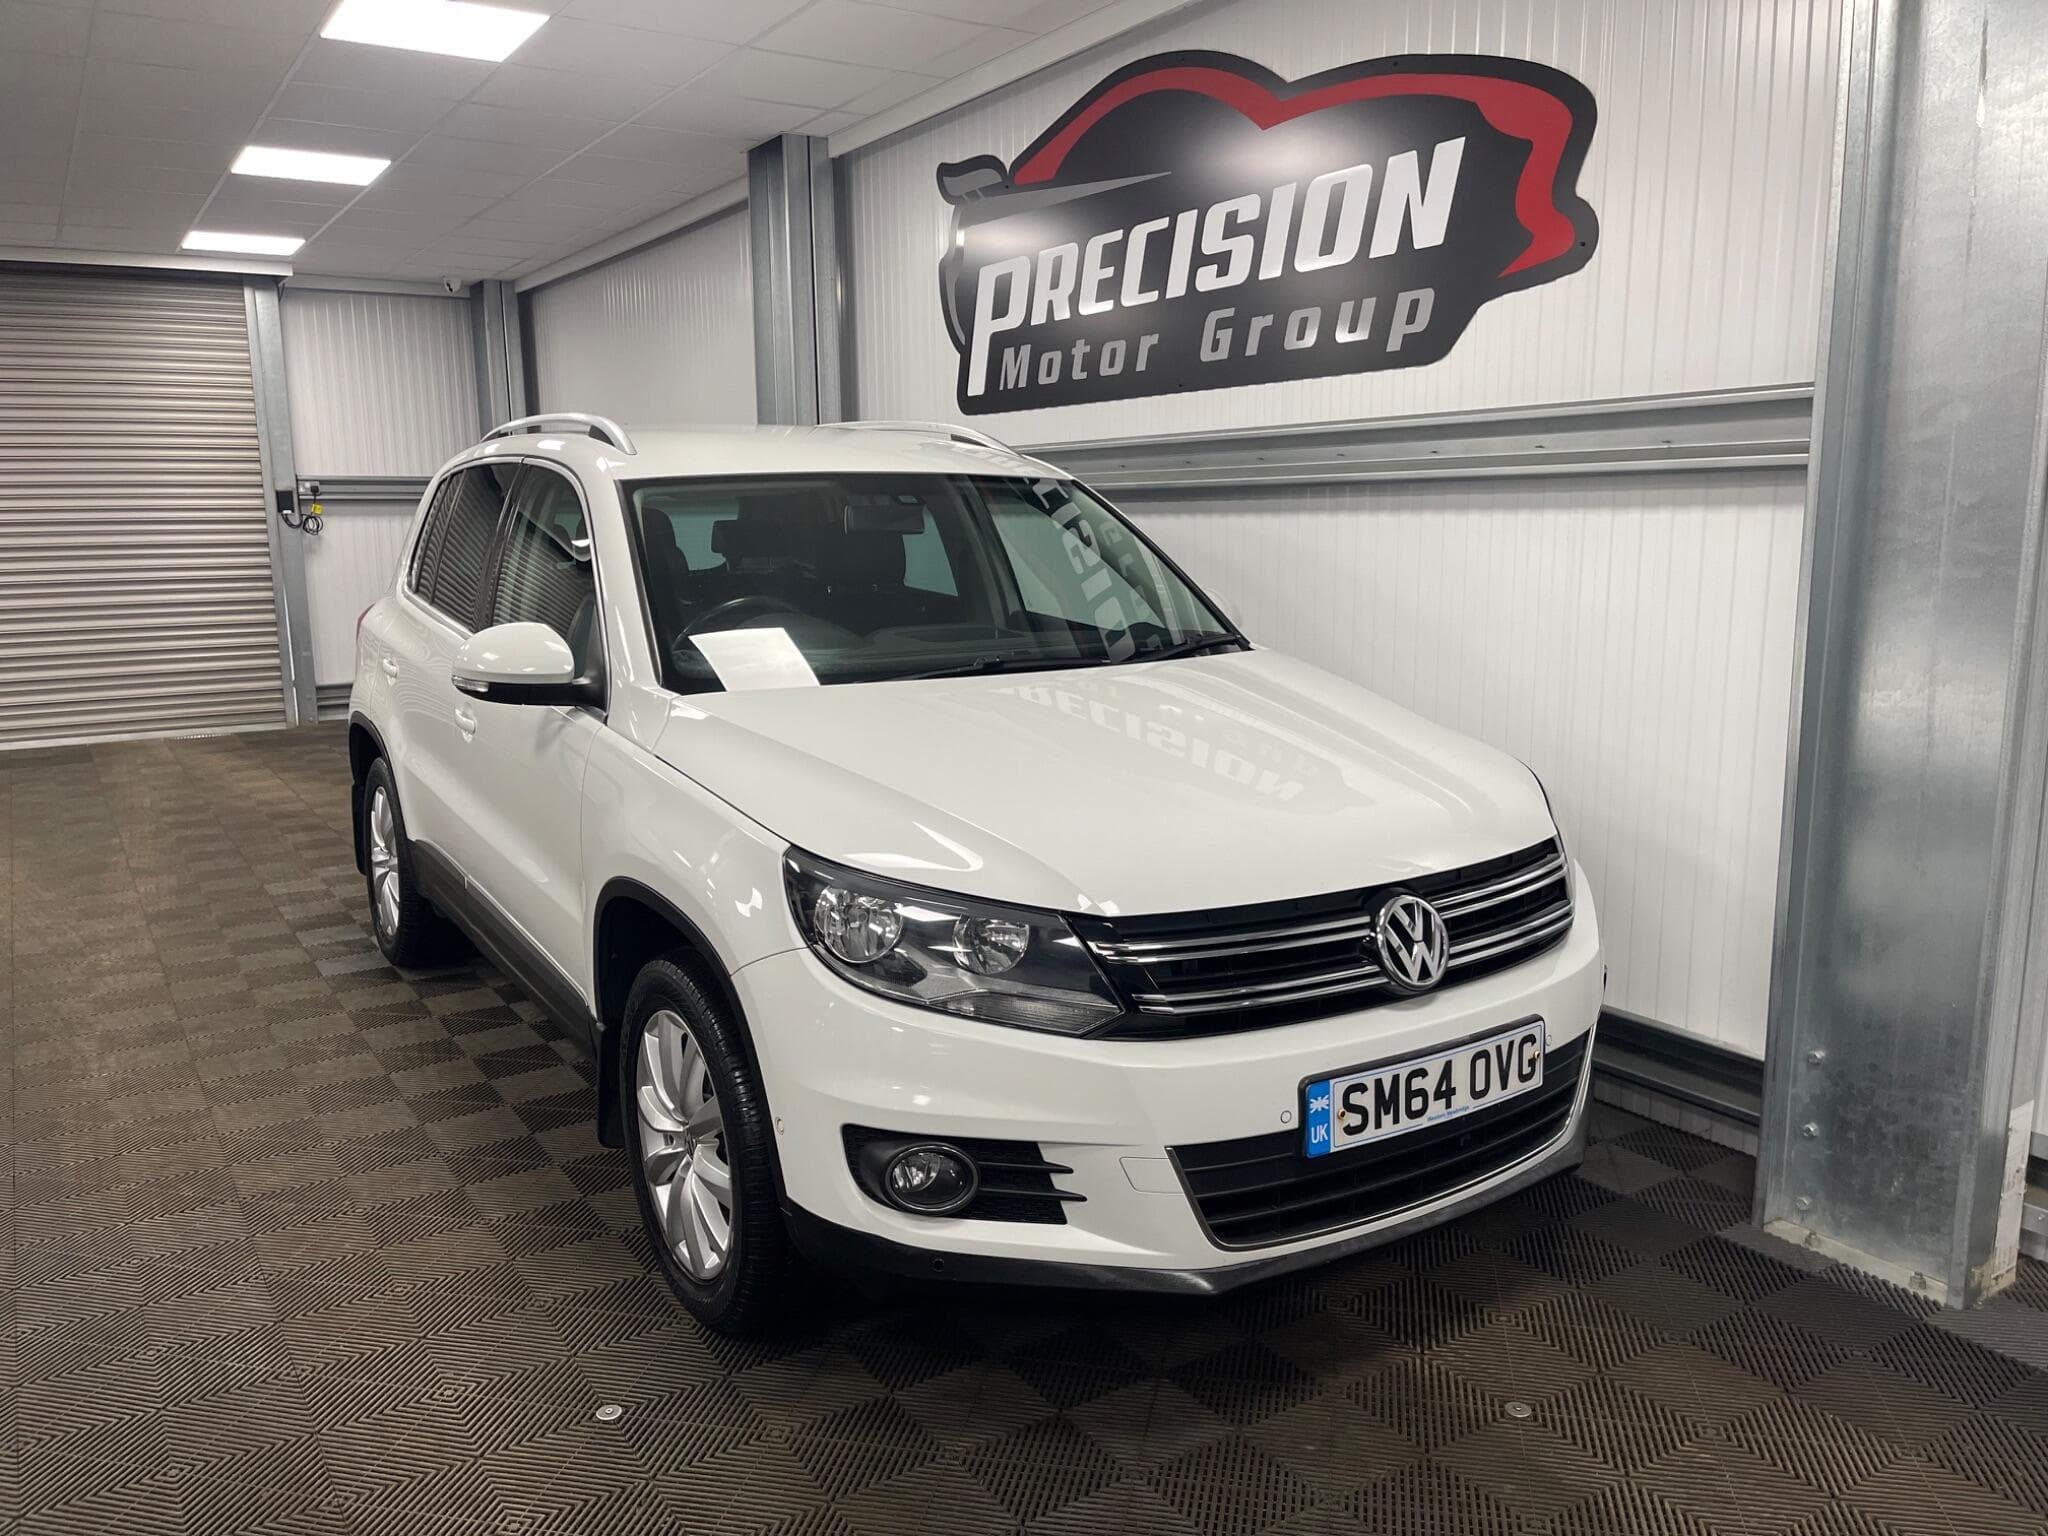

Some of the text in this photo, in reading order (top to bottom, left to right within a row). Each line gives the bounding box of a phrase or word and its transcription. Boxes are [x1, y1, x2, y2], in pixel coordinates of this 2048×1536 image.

[967, 136, 1466, 397] PRECISION
[999, 287, 1435, 392] Motor Group
[1311, 1123, 1329, 1144] UK
[1342, 1033, 1538, 1137] SM64 OVG
